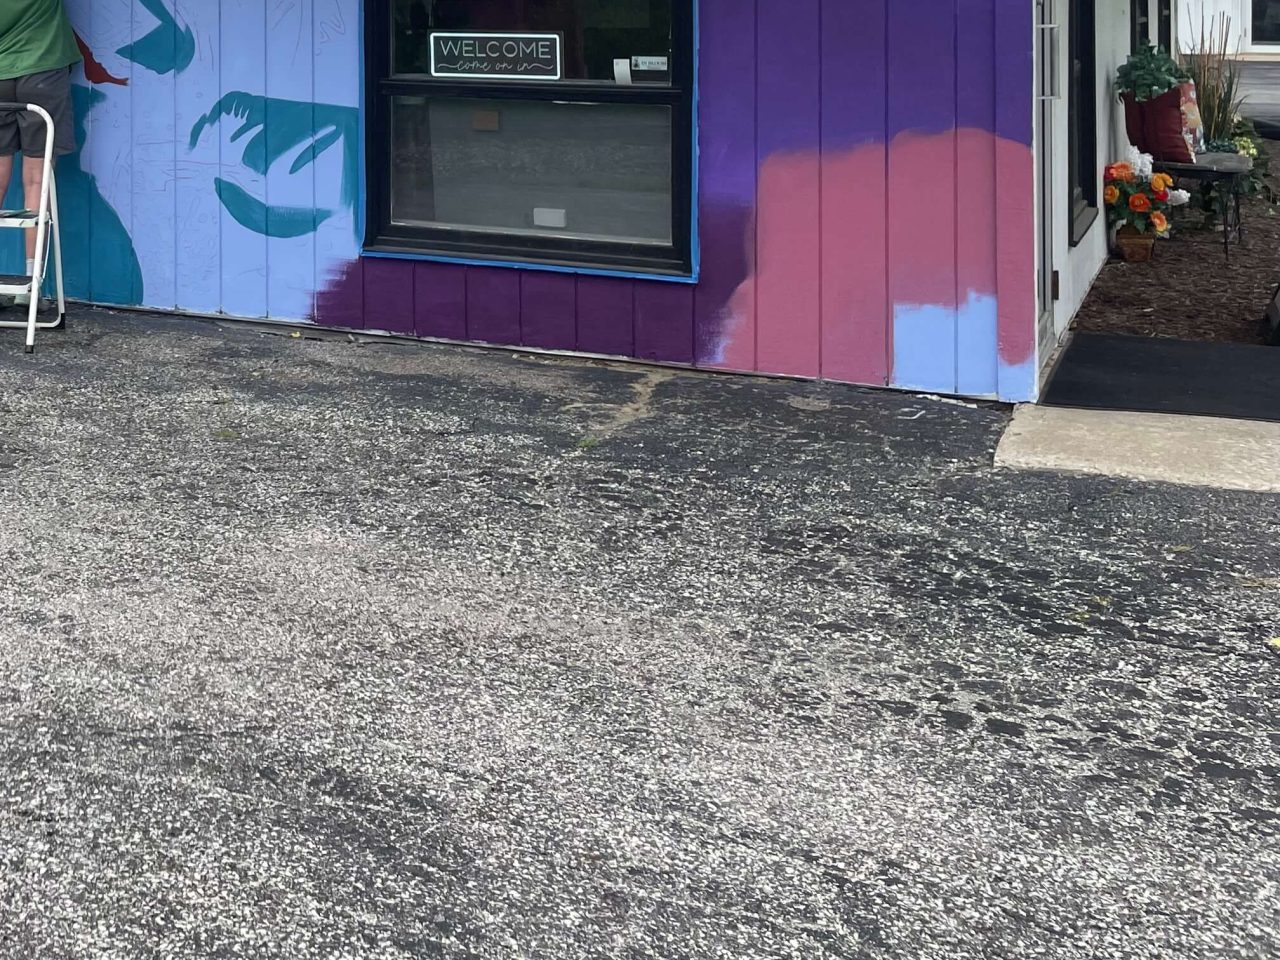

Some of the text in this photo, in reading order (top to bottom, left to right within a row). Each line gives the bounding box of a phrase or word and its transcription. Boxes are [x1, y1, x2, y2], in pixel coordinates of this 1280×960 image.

[440, 40, 551, 58] WELCOME
[456, 60, 491, 72] come
[495, 61, 513, 71] on
